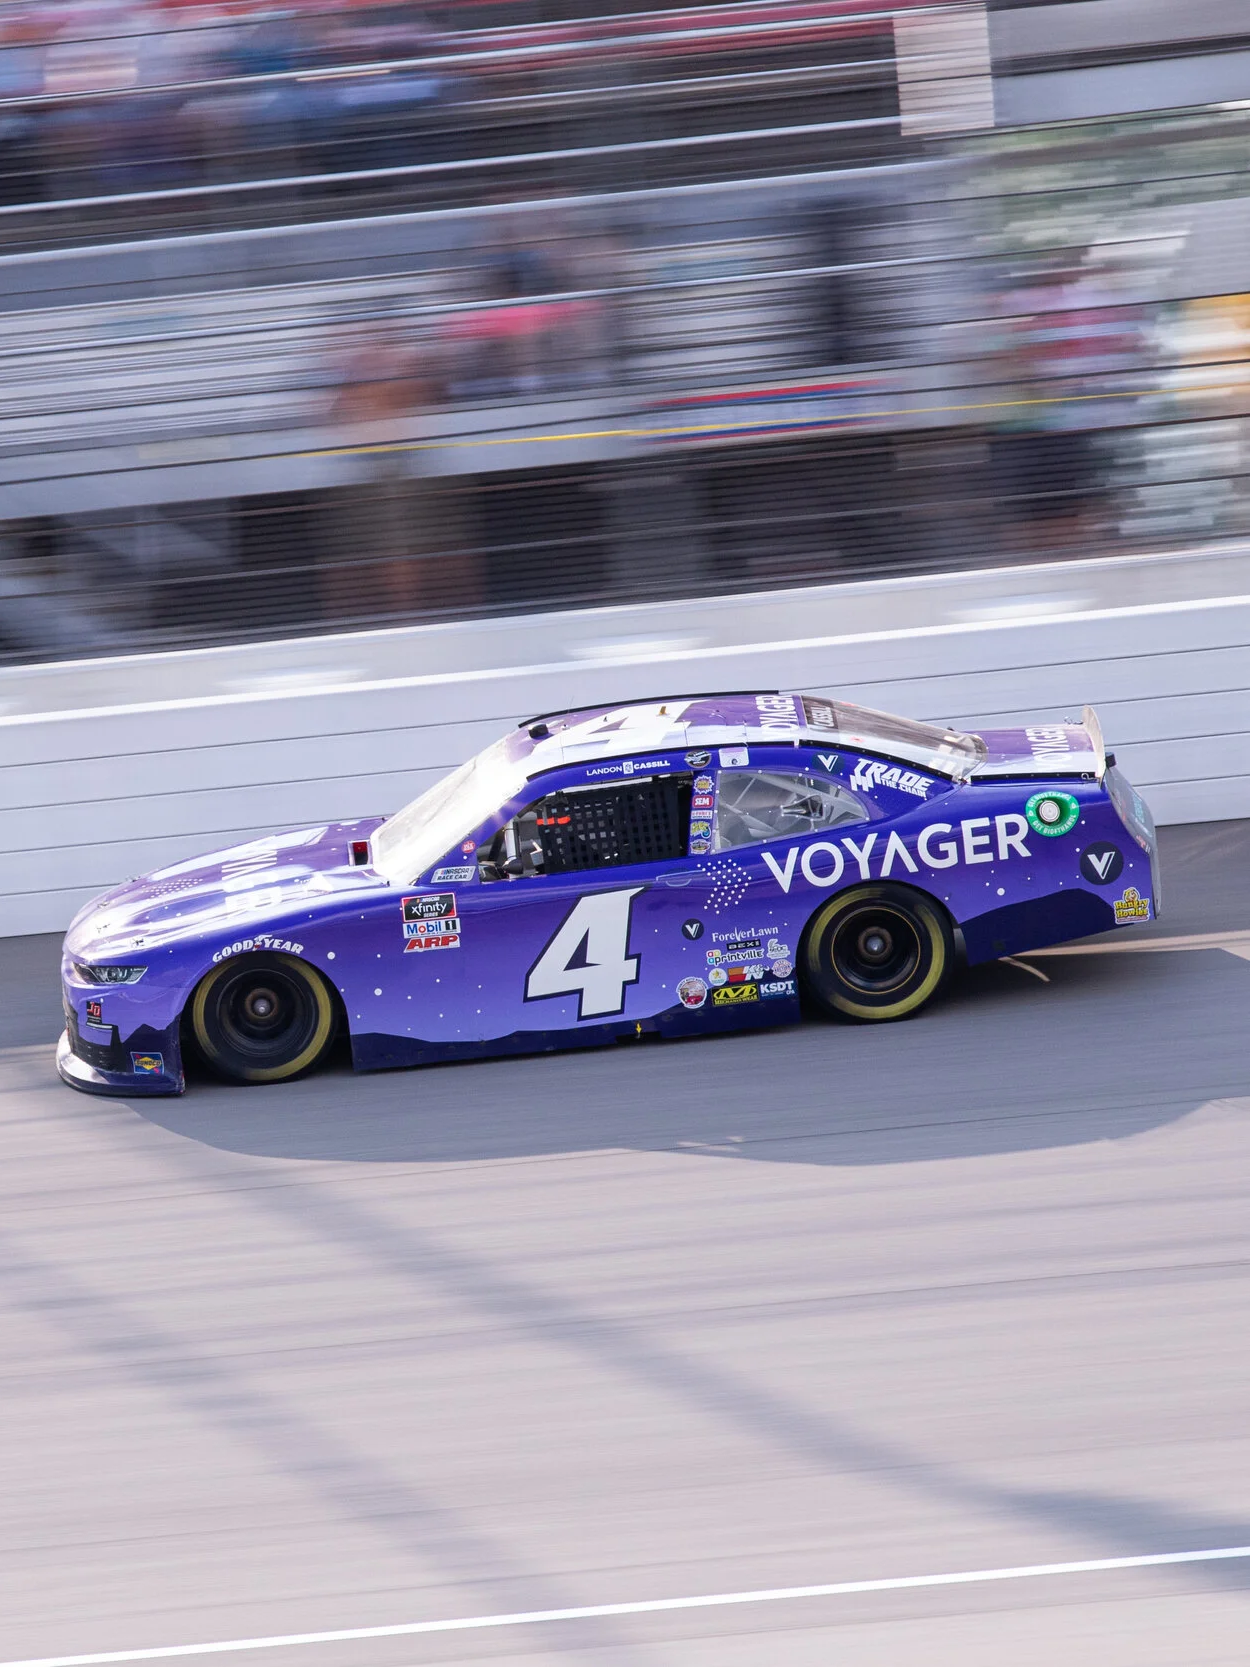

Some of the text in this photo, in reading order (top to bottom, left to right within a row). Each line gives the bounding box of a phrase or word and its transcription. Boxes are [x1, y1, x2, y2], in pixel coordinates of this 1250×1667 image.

[586, 760, 671, 776] LANDON CASSILL
[850, 758, 934, 792] TRADE
[880, 778, 898, 789] THE
[695, 797, 709, 806] SEM
[761, 813, 1032, 894] VOYAGER
[412, 902, 447, 916] xfinity
[406, 921, 442, 935] Mobil
[406, 935, 459, 950] ARP
[525, 887, 646, 1019] 4
[714, 949, 764, 965] printville
[760, 981, 794, 994] KSDT
